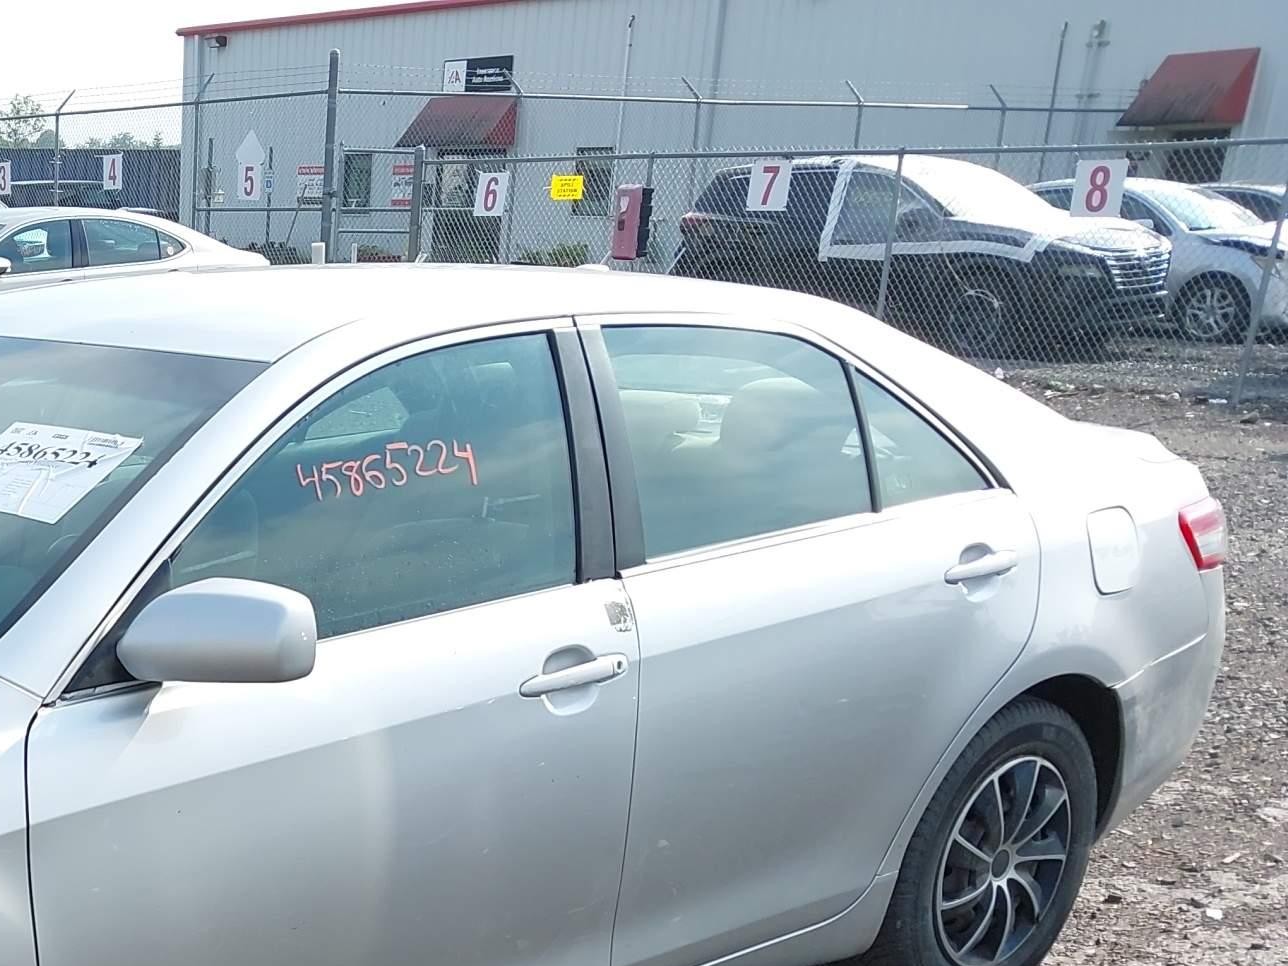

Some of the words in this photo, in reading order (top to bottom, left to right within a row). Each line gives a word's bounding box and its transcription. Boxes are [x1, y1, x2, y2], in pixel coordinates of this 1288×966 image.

[0, 165, 7, 191] 3
[108, 158, 117, 186] 4
[243, 166, 254, 197] 5
[760, 165, 781, 206] 7
[1085, 165, 1111, 213] 8
[483, 176, 500, 212] 6
[296, 439, 479, 501] 45865224
